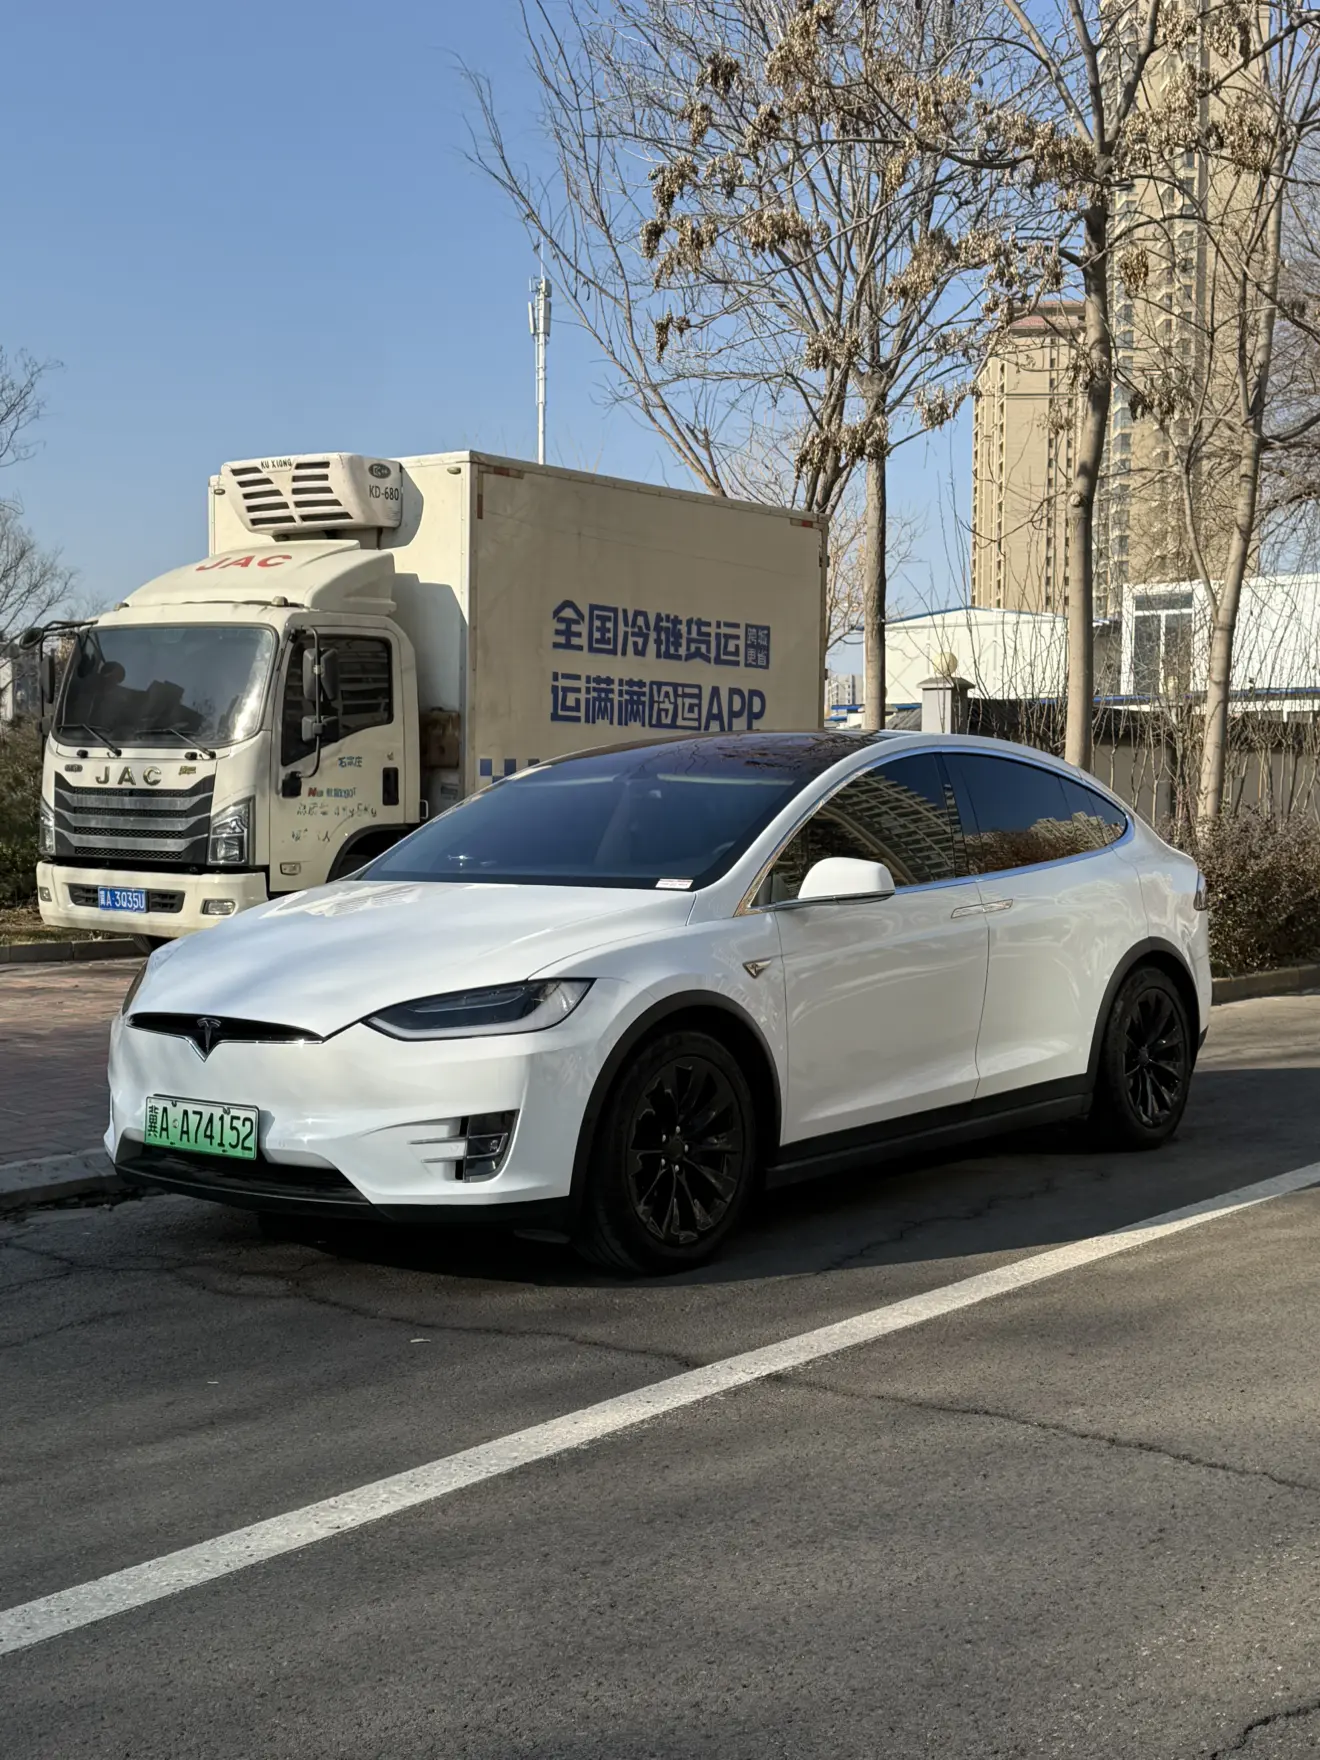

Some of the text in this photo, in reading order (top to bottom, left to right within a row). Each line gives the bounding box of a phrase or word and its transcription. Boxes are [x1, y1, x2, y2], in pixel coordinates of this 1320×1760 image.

[261, 460, 270, 469] KU
[368, 484, 400, 501] KD-680
[195, 554, 292, 571] JAC
[552, 599, 741, 667] 全国冷链货运
[747, 646, 768, 666] 更省
[95, 765, 162, 786] JAC
